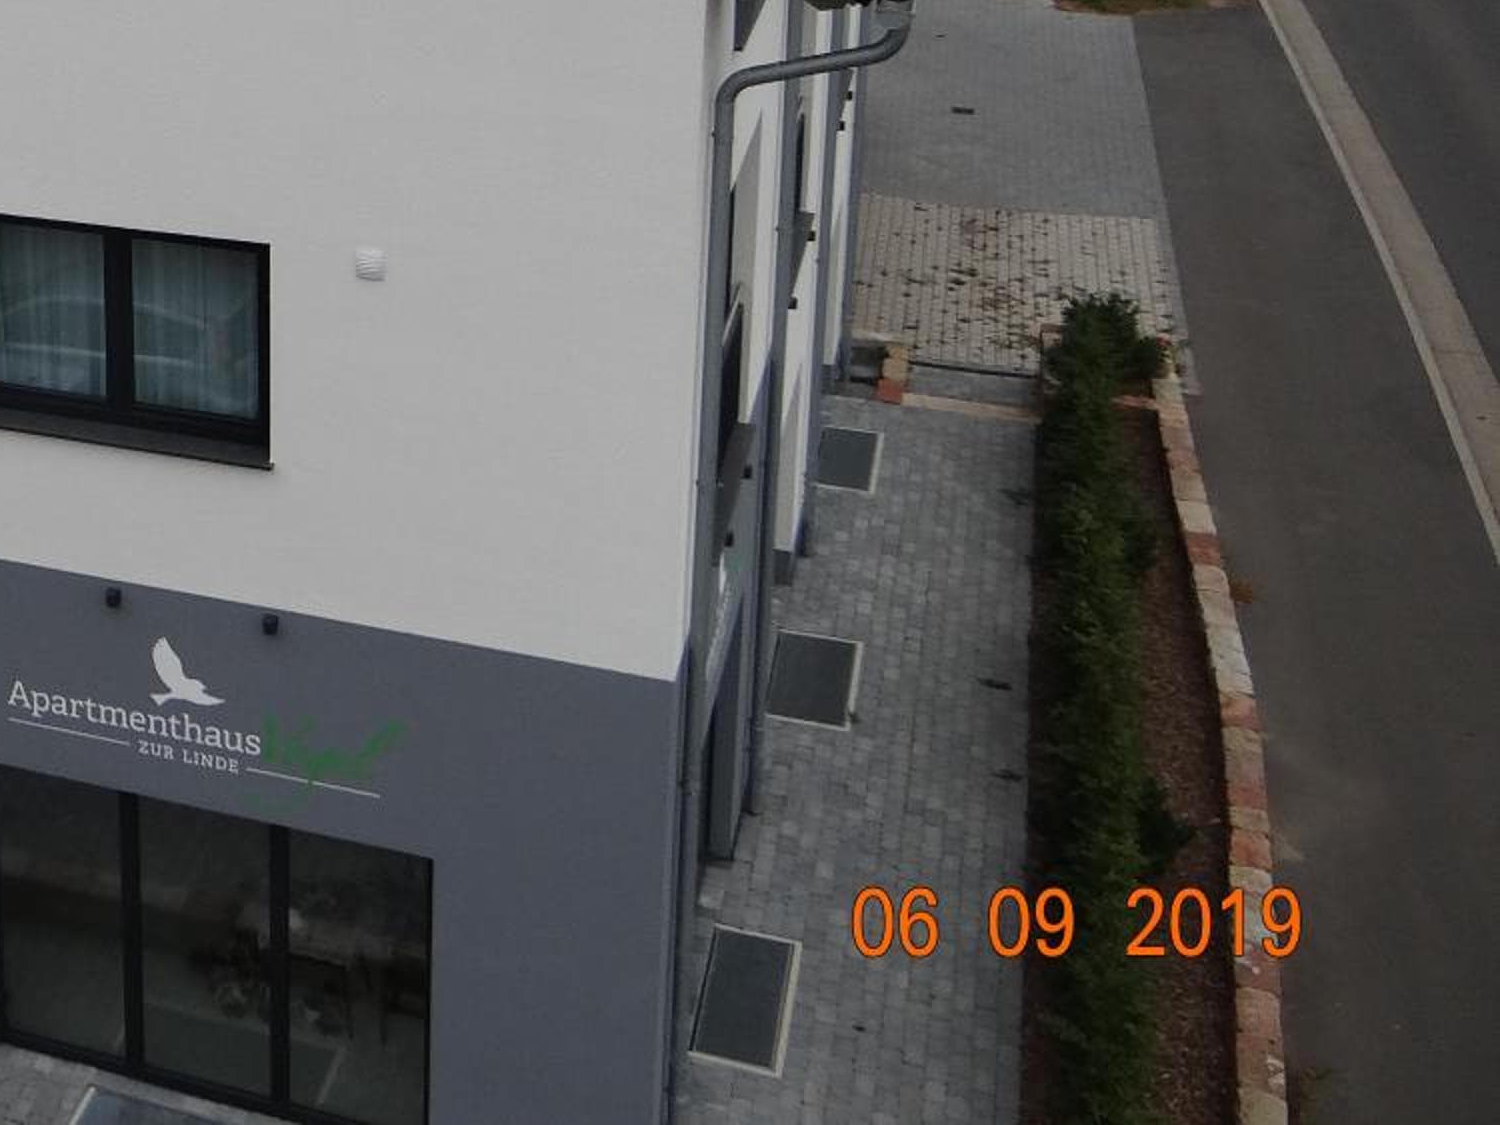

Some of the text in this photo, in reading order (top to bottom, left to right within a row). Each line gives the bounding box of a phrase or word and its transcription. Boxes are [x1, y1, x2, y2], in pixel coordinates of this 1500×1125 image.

[7, 679, 262, 756] Apartmenthaus
[137, 740, 240, 775] ZUR LINDE
